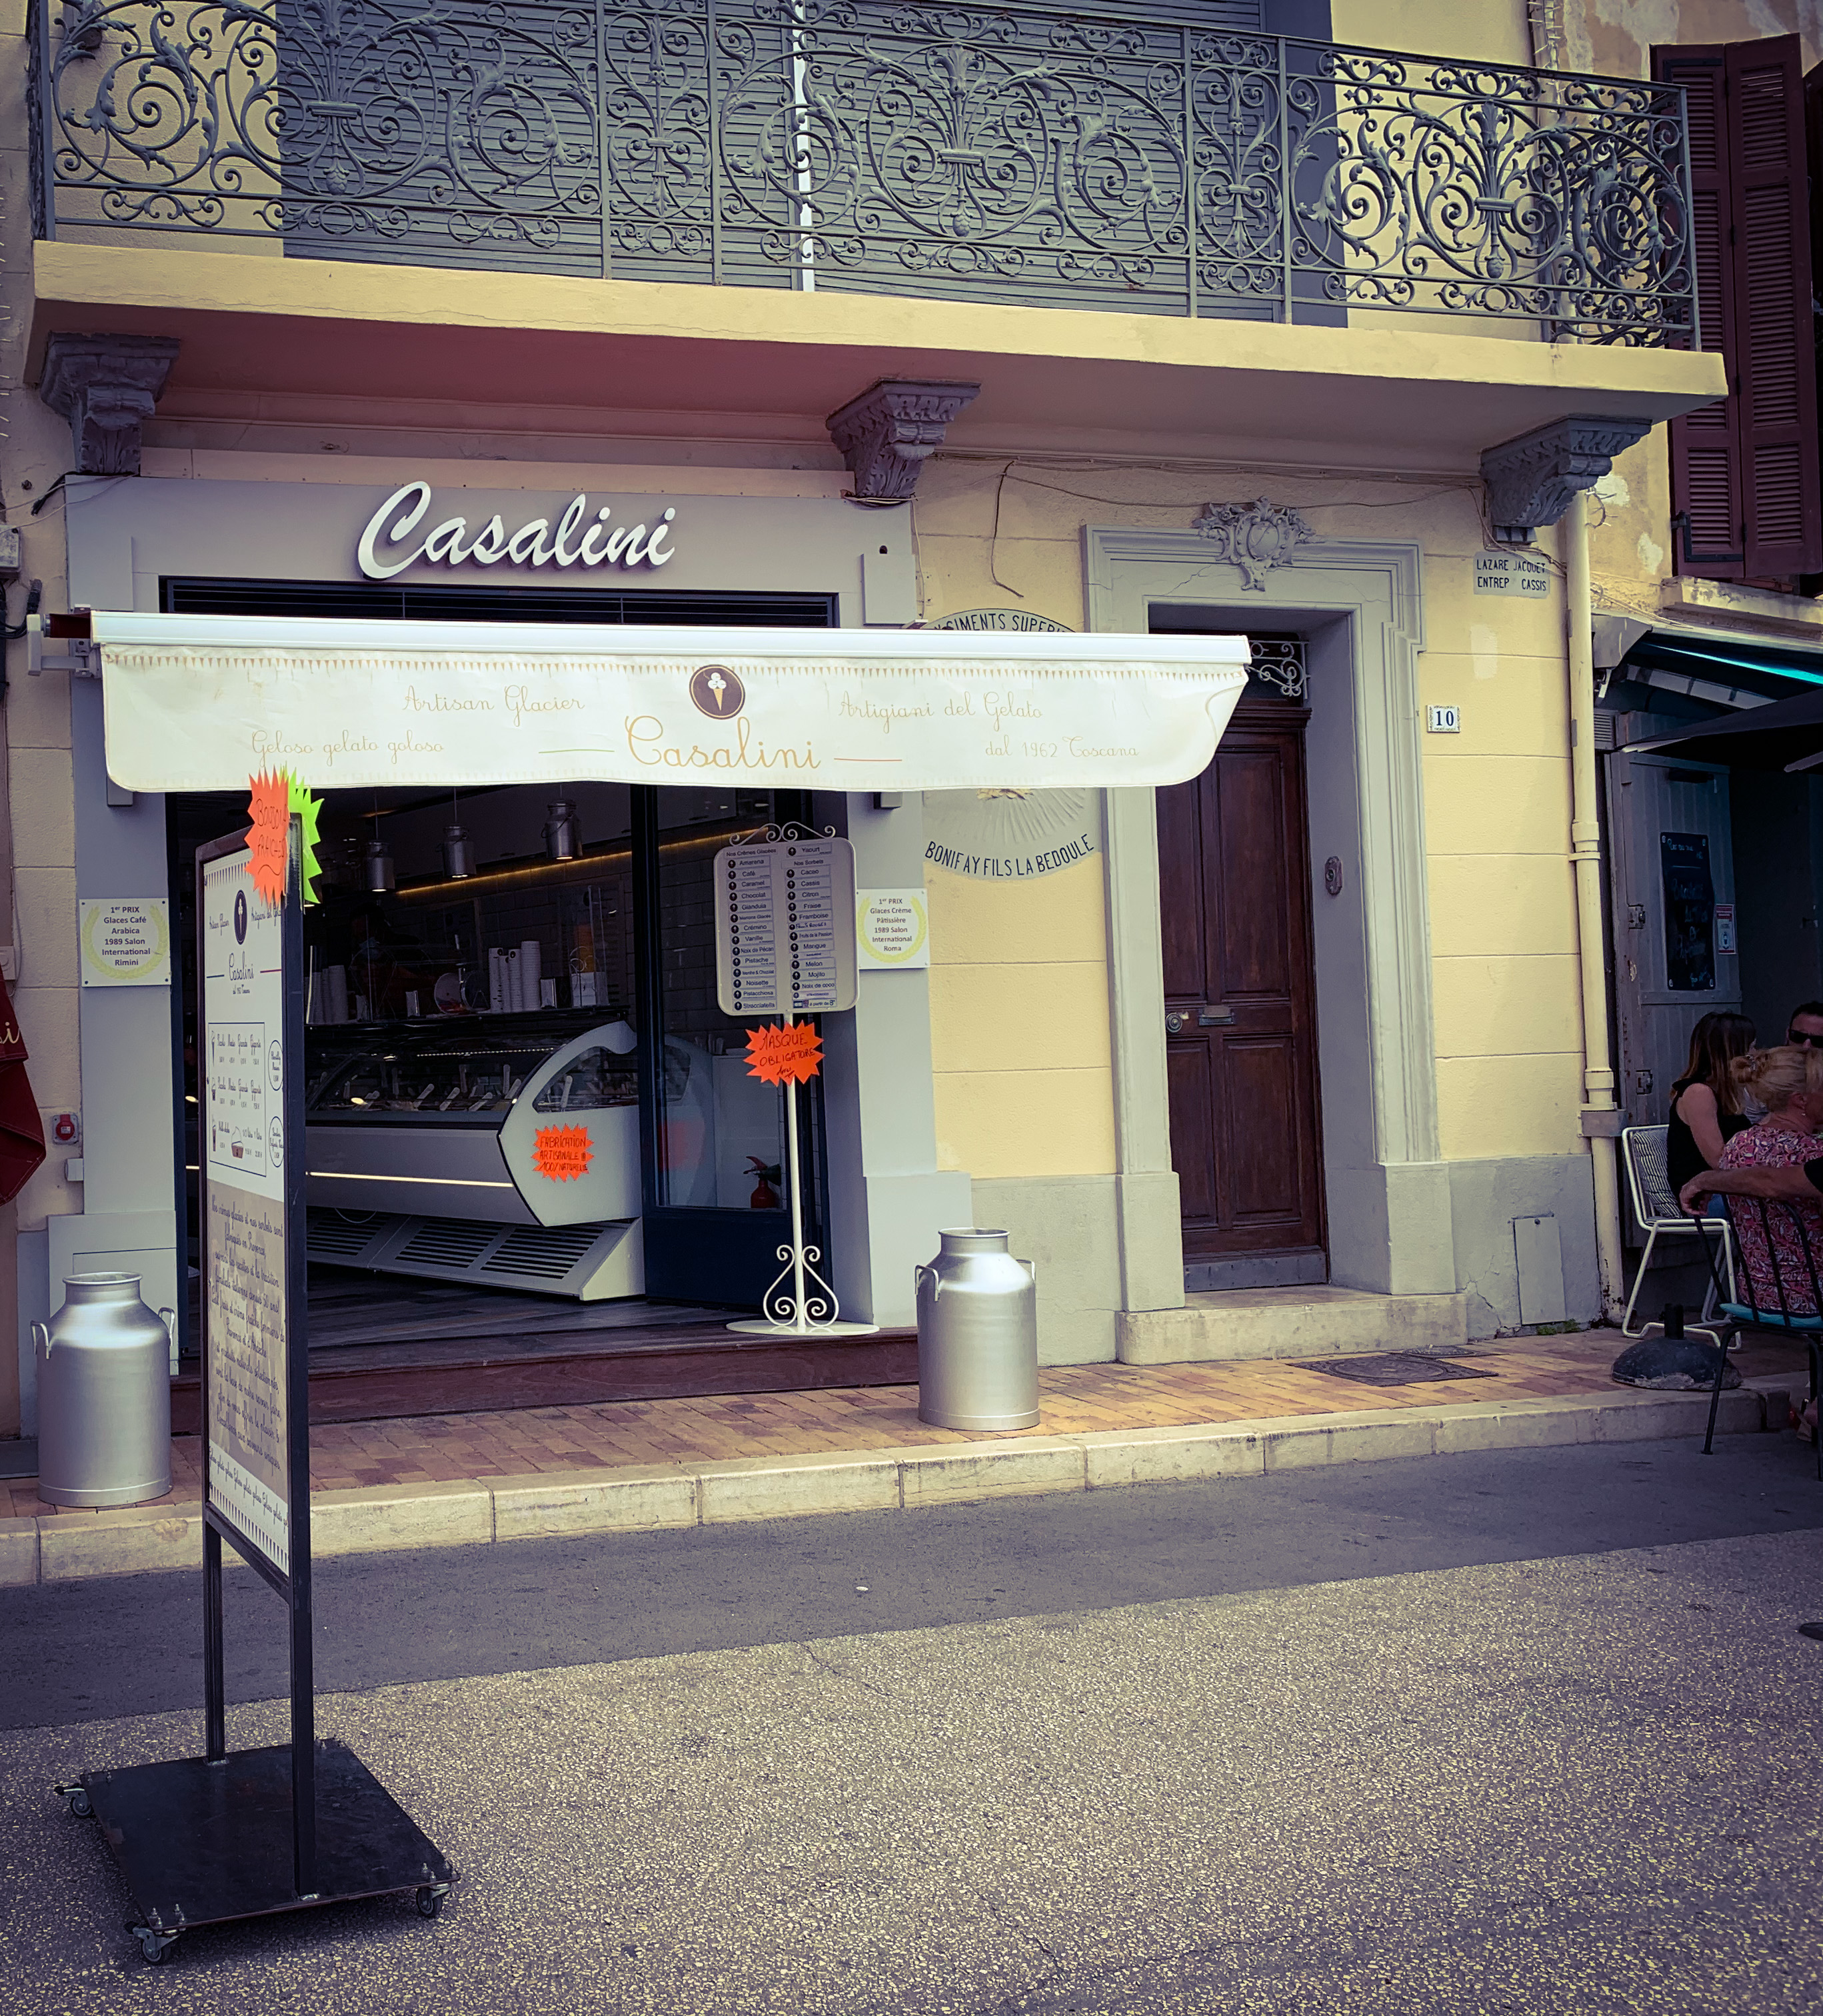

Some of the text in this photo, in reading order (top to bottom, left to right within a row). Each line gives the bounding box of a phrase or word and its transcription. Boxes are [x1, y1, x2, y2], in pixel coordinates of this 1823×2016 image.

[357, 481, 675, 579] Casalini
[1476, 559, 1509, 571] LAZARE
[1477, 576, 1546, 591] ENTREP CASSIS
[402, 684, 585, 727] Artisan Glacier
[838, 691, 1043, 734] Artigiani del Gelato
[1436, 711, 1454, 727] 10
[251, 729, 444, 767] Geloso gelato goloso
[625, 714, 821, 769] Casalini
[985, 735, 1140, 758] dal 1962 Toscana
[984, 858, 1012, 876] FILS
[1016, 857, 1034, 875] LA
[1036, 833, 1094, 872] BEDOULE
[102, 947, 151, 955] International
[229, 951, 255, 981] Casalini
[540, 1135, 586, 1148] FABRICATION
